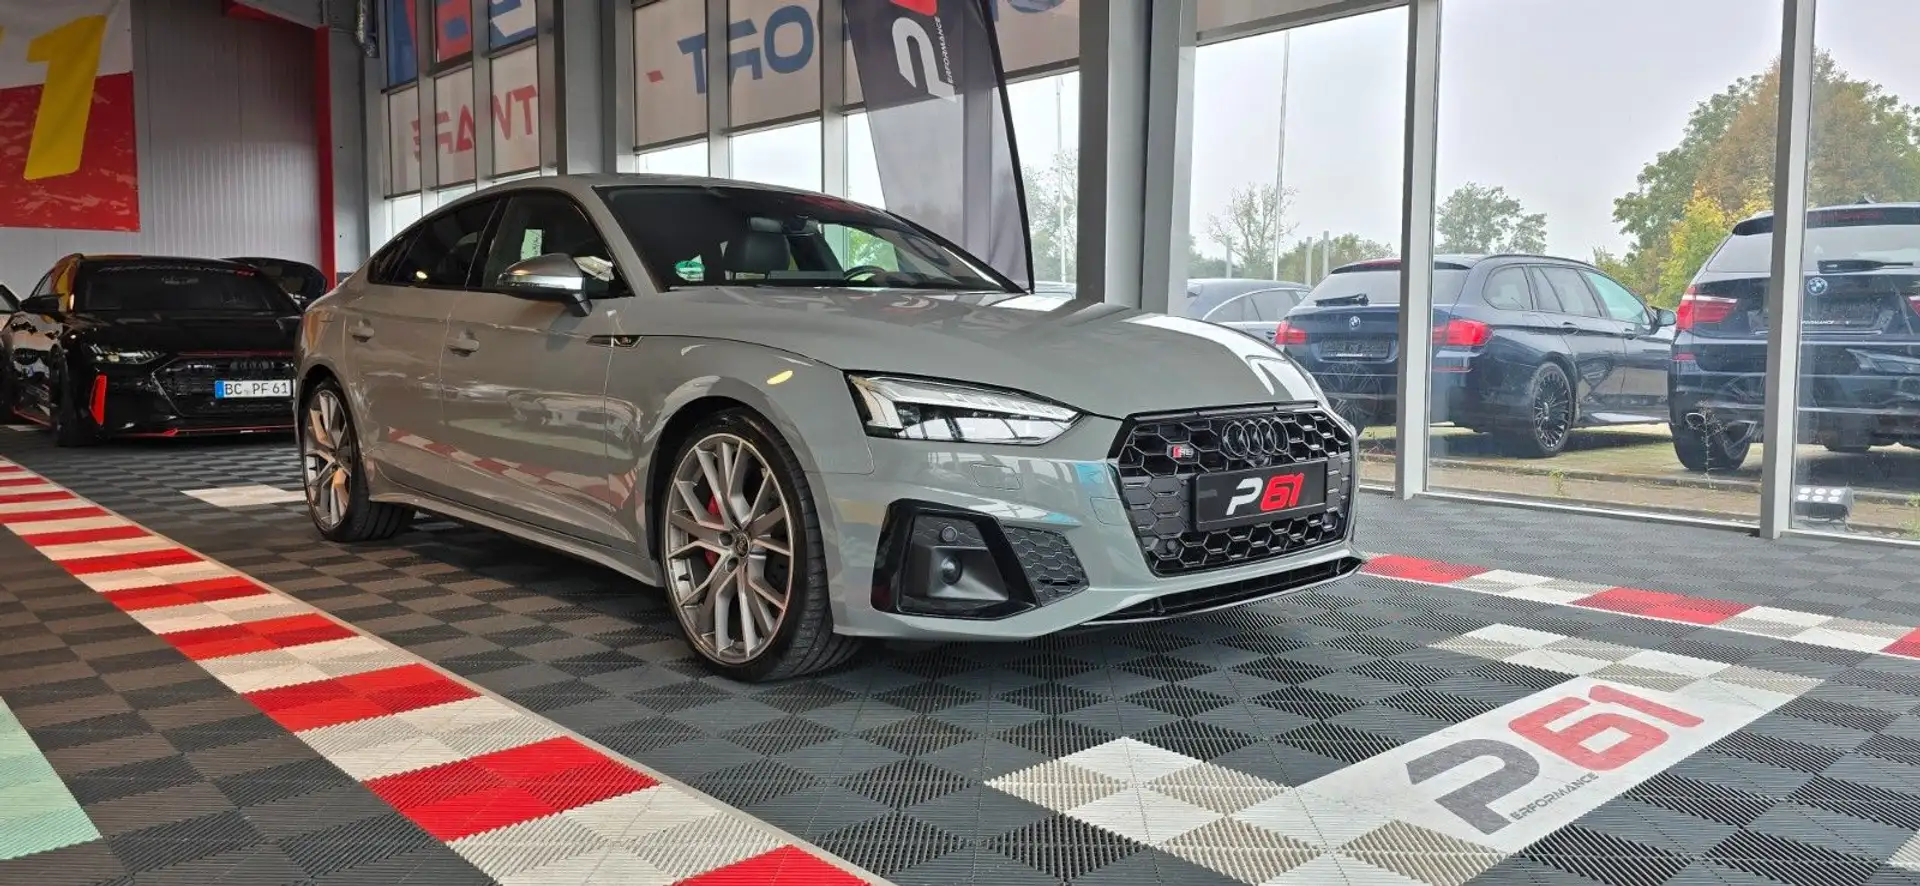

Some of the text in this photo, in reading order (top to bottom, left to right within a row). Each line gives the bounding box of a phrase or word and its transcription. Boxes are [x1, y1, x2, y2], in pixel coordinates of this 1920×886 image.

[0, 14, 108, 181] 1
[225, 382, 288, 395] BC PF 61
[1226, 472, 1305, 516] P61
[1406, 684, 1705, 835] P61
[1510, 771, 1599, 821] ERFORMANCE
